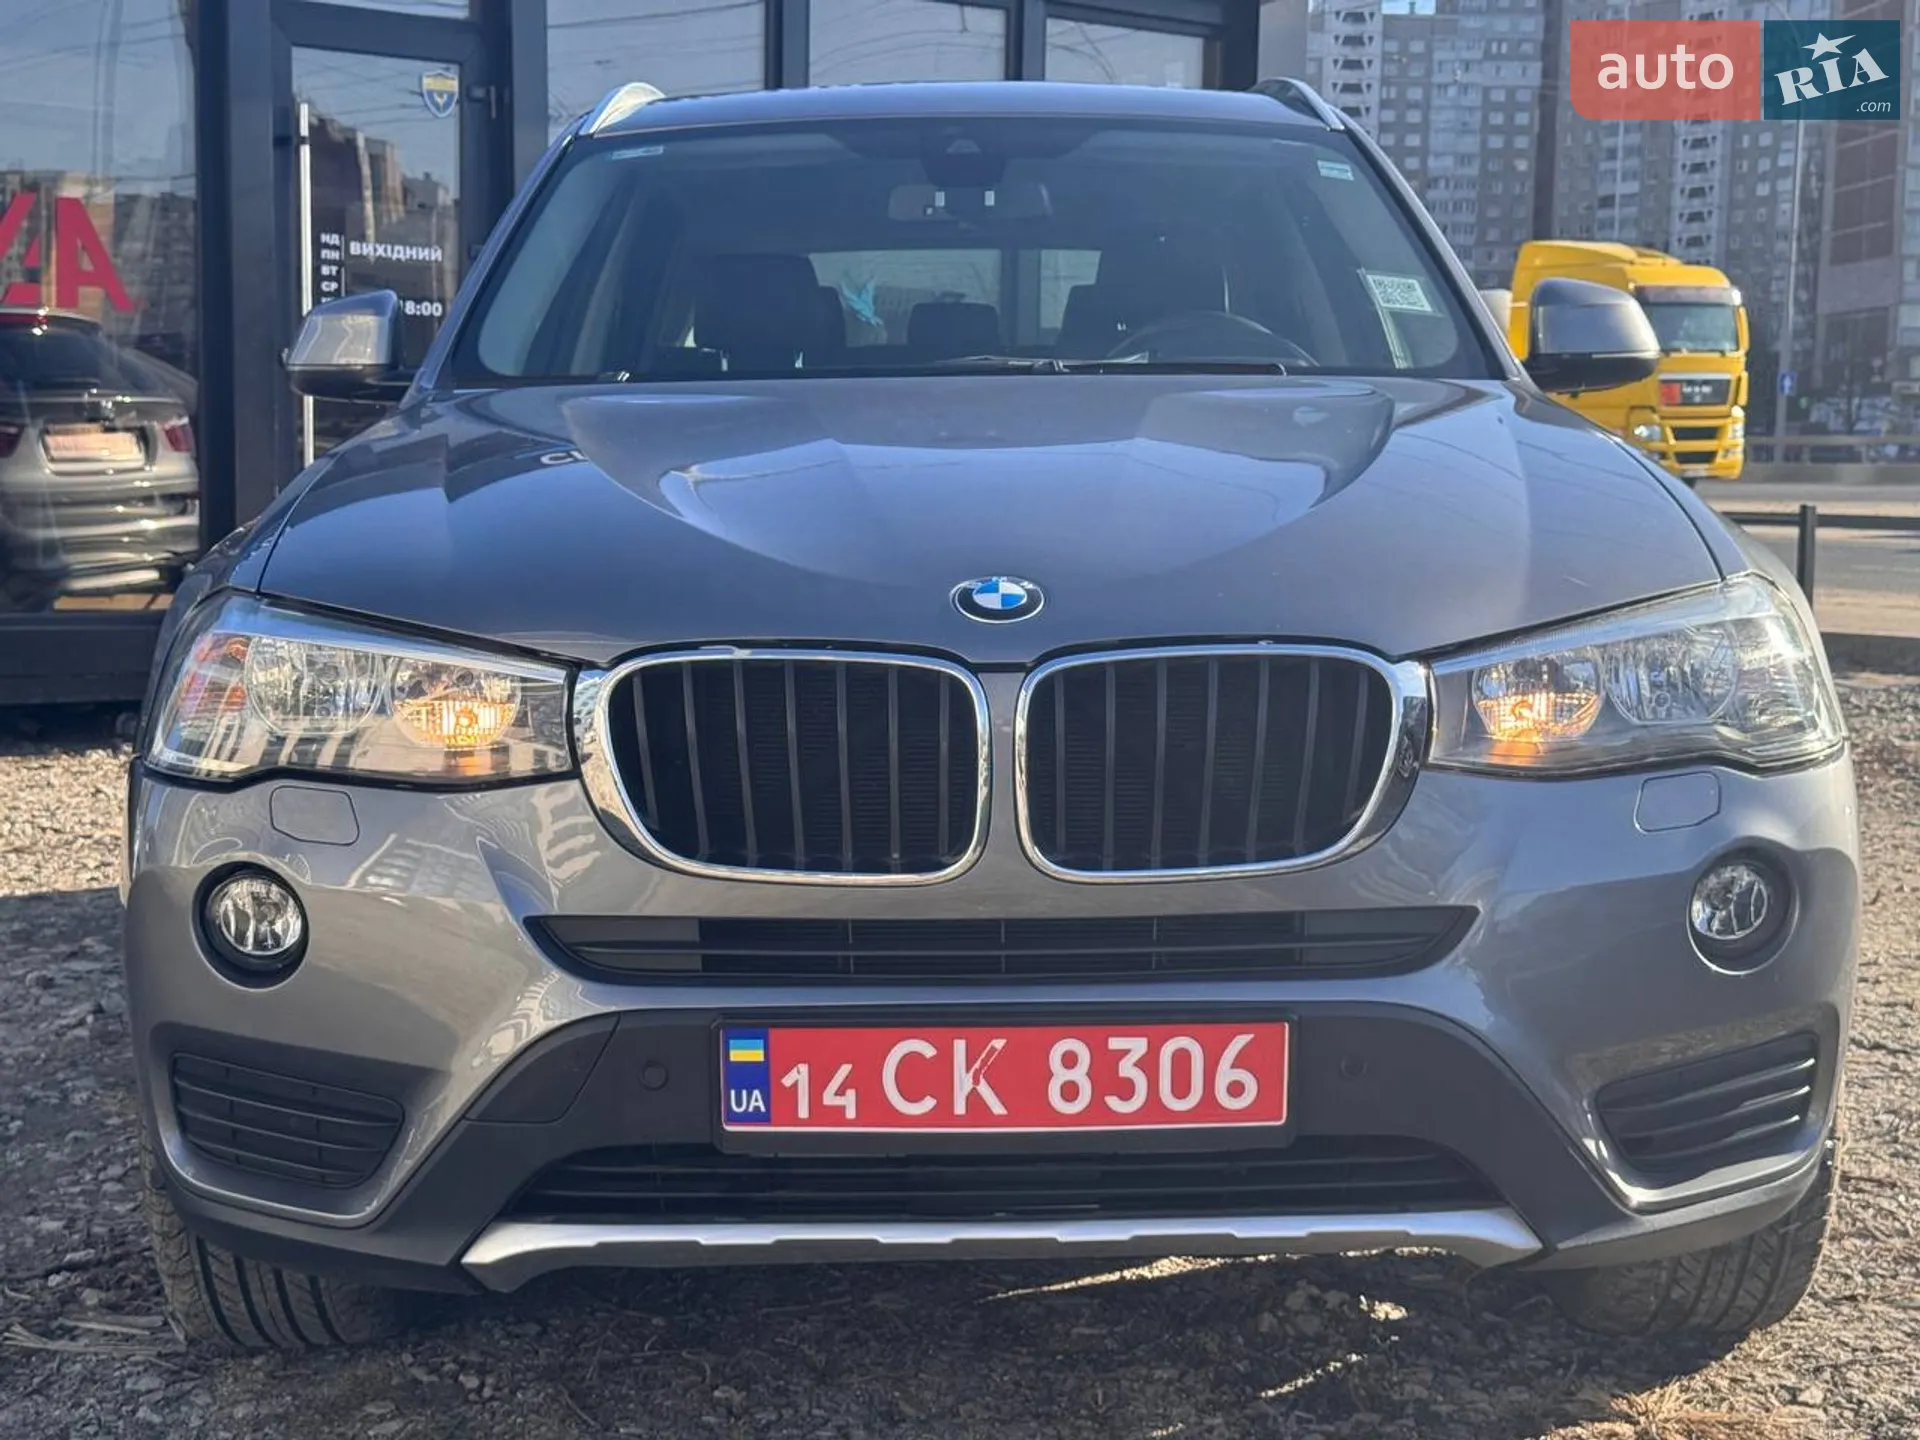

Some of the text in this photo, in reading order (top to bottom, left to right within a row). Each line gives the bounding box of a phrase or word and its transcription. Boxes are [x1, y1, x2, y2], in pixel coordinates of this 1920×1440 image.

[320, 248, 340, 261] ПН
[349, 240, 443, 262] ВИХІДНИЙ
[321, 264, 339, 276] ВТ
[321, 280, 339, 292] СР
[780, 1033, 1259, 1120] 14 CK 8306
[729, 1088, 767, 1113] UA
